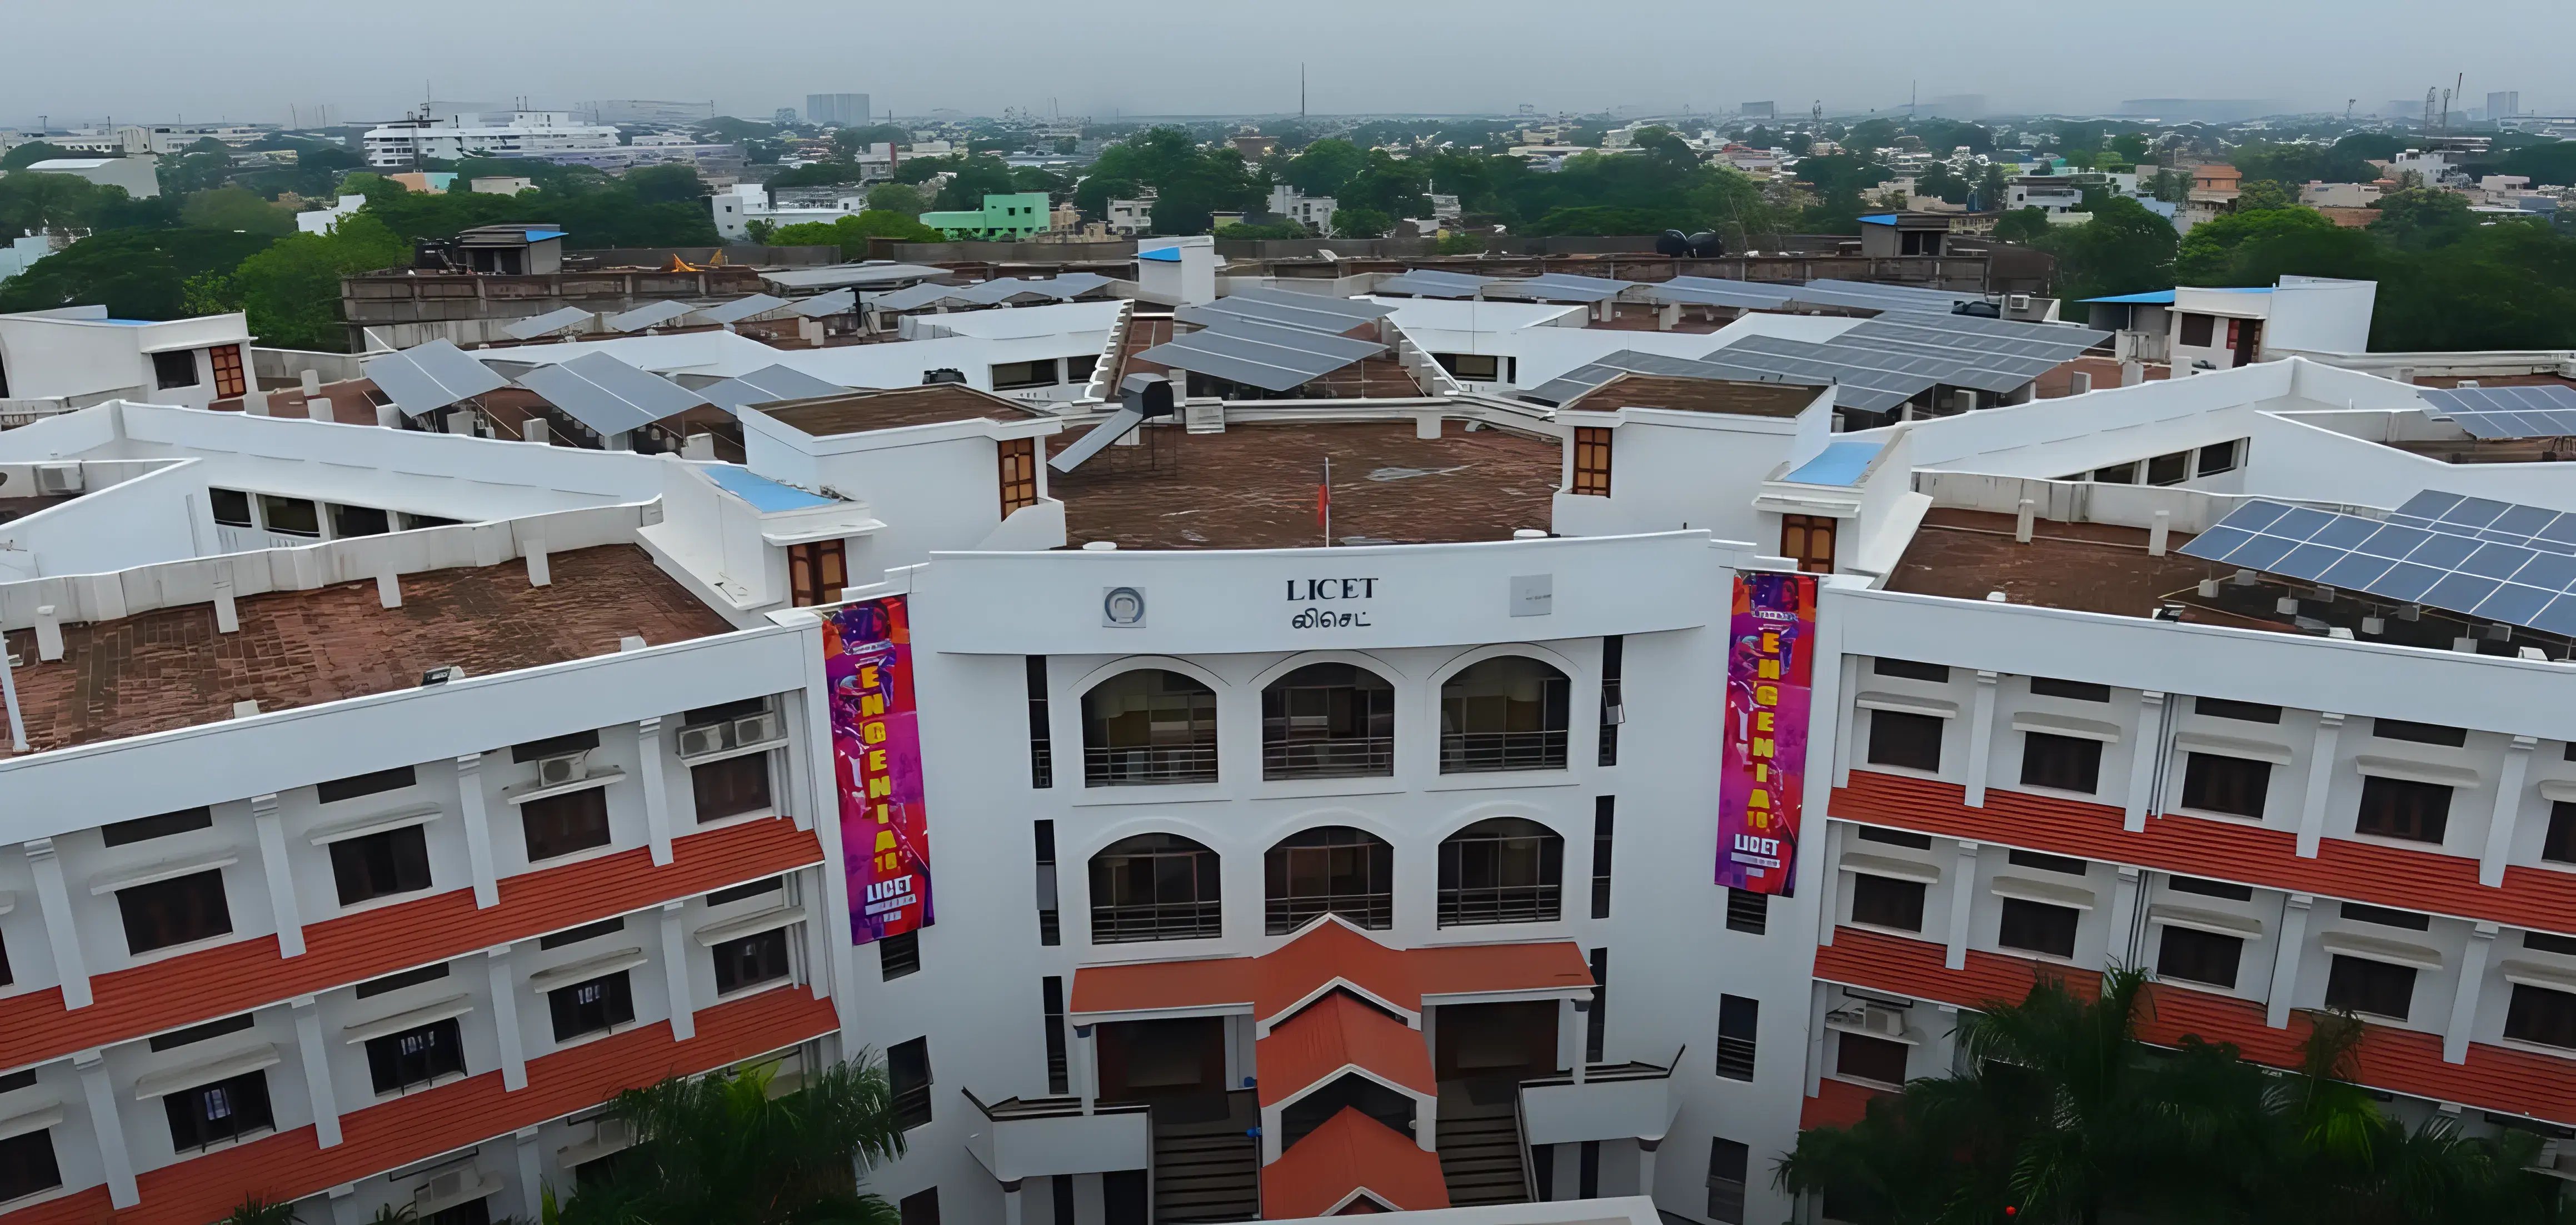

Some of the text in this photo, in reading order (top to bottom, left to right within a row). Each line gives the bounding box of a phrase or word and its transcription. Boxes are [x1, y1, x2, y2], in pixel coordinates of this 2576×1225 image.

[1286, 577, 1379, 601] LICET
[1292, 607, 1371, 629] லிசெட்
[1747, 632, 1780, 809] ENGENIA
[861, 665, 897, 853] ENGENIA
[867, 875, 912, 903] LICET
